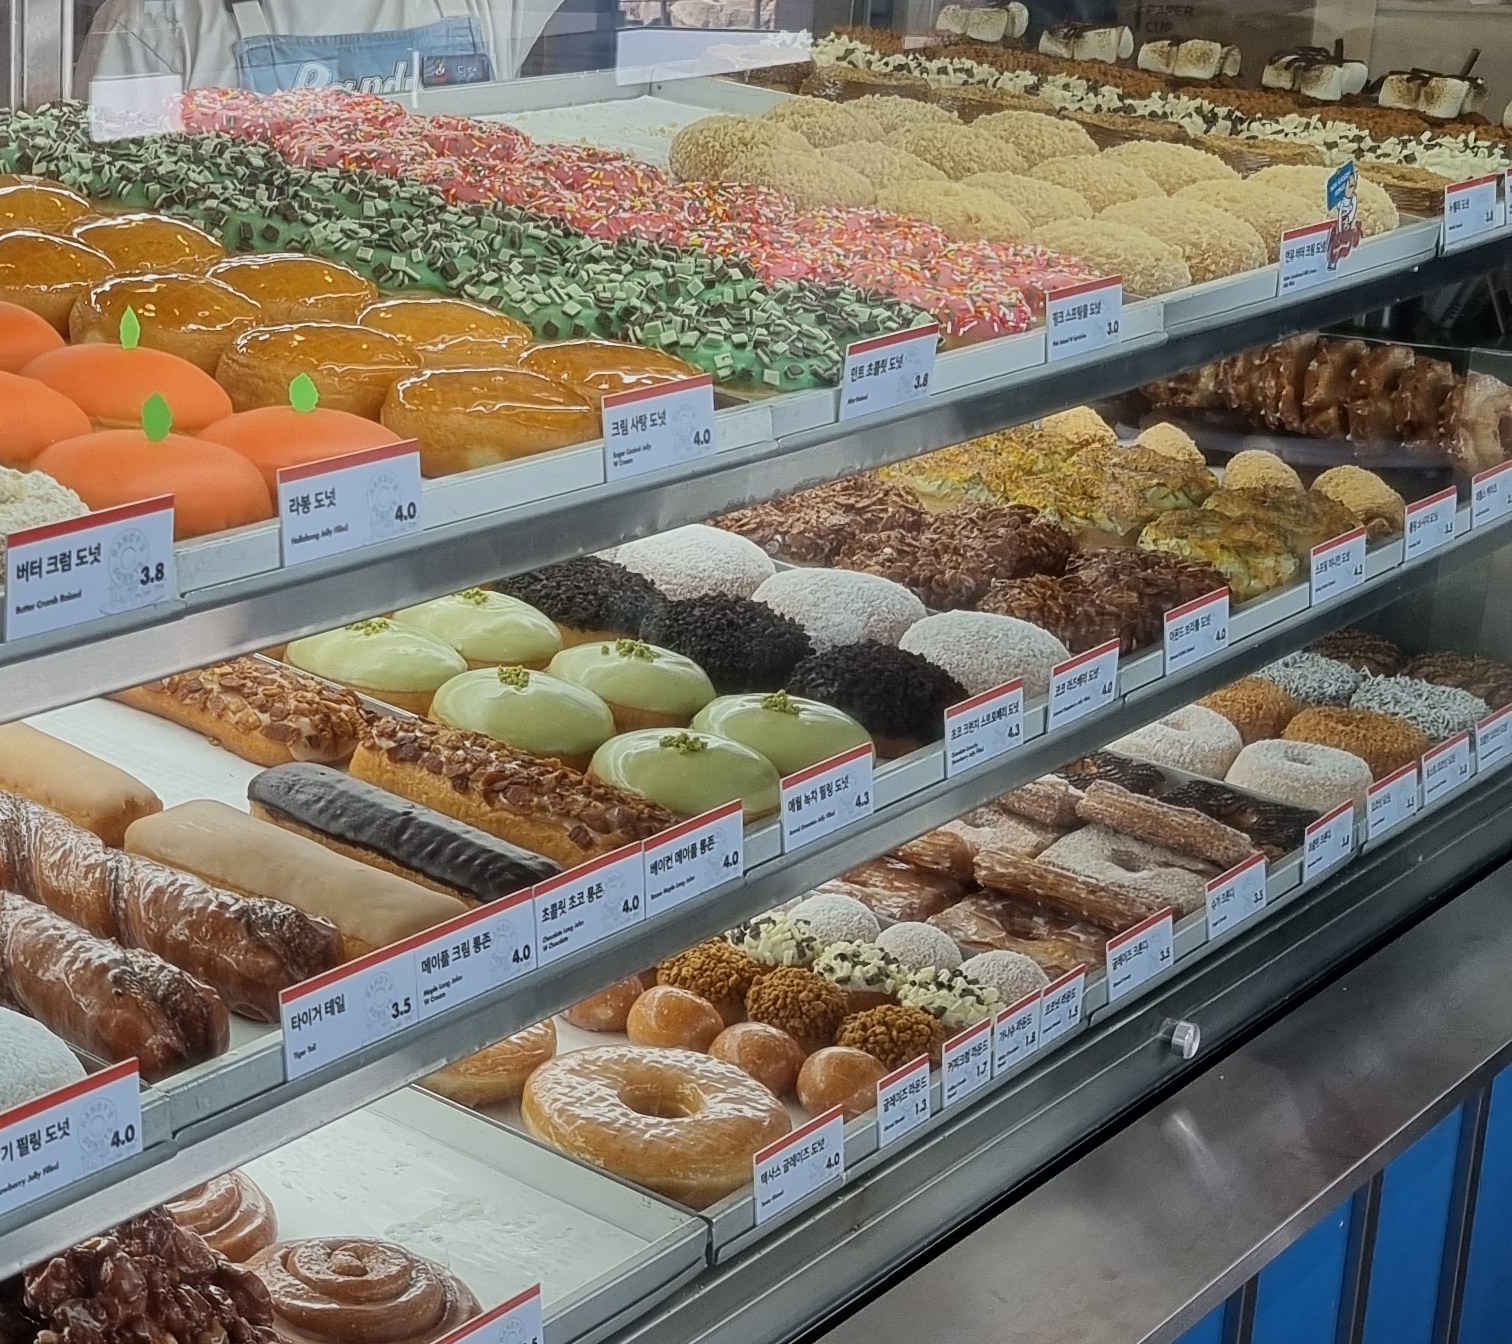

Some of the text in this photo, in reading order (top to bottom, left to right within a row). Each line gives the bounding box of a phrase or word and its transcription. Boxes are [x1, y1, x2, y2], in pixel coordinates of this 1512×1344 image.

[1088, 299, 1102, 316] 도넛
[888, 353, 904, 372] 도넛
[611, 408, 667, 437] 크림 사탕 도넛
[693, 428, 711, 446] 4.0
[288, 485, 338, 516] 라봉 도넛
[394, 500, 417, 522] 4.0
[15, 541, 102, 583] 버터 크럼 도넛
[139, 561, 165, 586] 3.8
[834, 773, 850, 793] 도넛
[855, 790, 870, 808] 4.3
[650, 852, 673, 876] 베이컨
[674, 841, 698, 864] 메이플
[723, 850, 739, 869] 4.0
[541, 881, 604, 923] 초콜릿 초코 롱존
[621, 894, 640, 915] 4.0
[421, 931, 492, 975] 메이플 크림 롱존
[511, 944, 531, 965] 4.0
[291, 993, 346, 1032] 타이거 테일
[391, 997, 412, 1020] 3.5
[915, 1098, 927, 1115] 1.3
[16, 1129, 42, 1158] 필링
[44, 1116, 71, 1145] 도넛
[110, 1123, 136, 1149] 4.0
[782, 1146, 811, 1174] 글레이즈
[810, 1137, 826, 1156] 도넛
[826, 1152, 841, 1169] 4.0
